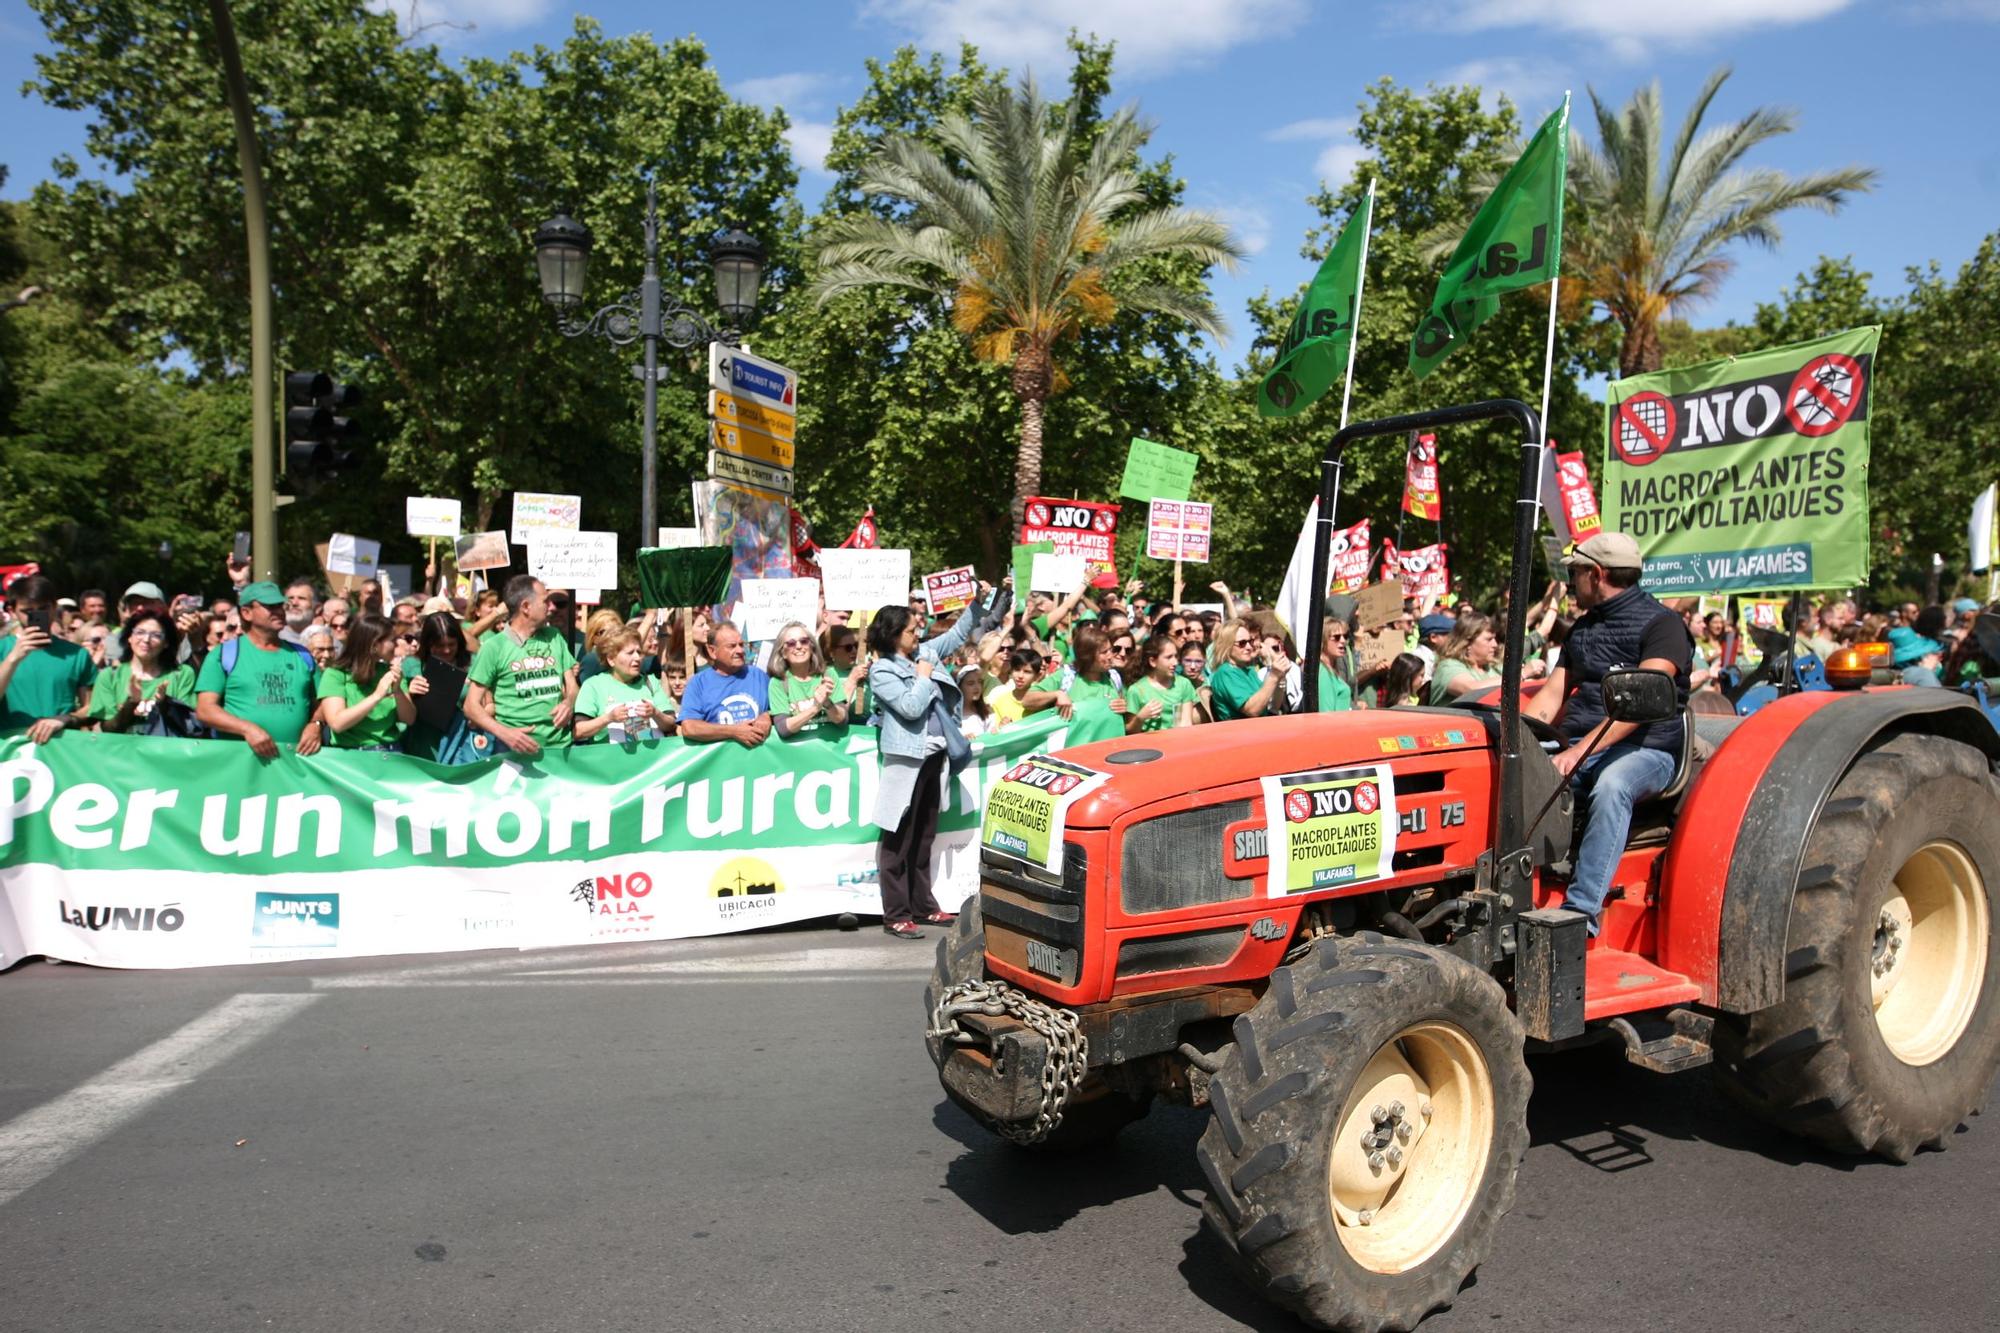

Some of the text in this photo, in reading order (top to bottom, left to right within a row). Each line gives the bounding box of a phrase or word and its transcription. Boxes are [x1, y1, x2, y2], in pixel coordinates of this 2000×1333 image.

[744, 371, 783, 393] TOURIST INFO
[1681, 384, 1782, 447] NO
[771, 445, 791, 460] REAL
[1620, 447, 1845, 507] MACROPLANTES
[1052, 506, 1091, 528] NO
[1619, 484, 1845, 537] FOTOVOLTAIQUES
[1027, 529, 1110, 549] MACROPLANTES
[1707, 547, 1807, 579] VILAFAMÉS
[940, 573, 959, 586] NO
[1664, 574, 1695, 585] nostra
[523, 657, 546, 669] NO
[515, 668, 559, 682] MAGDA
[1021, 767, 1058, 787] NO
[0, 745, 180, 851] Per
[200, 792, 343, 858] un
[372, 761, 612, 858] món
[641, 734, 882, 844] rural
[992, 788, 1051, 817] MACROPLANTES
[1313, 789, 1352, 815] NO
[988, 802, 1048, 832] FOTOVOLTAIQUES
[1440, 801, 1466, 827] 75
[1291, 822, 1378, 846] MACROPLANTES
[1291, 838, 1378, 861] FOTOVOLTAIQUES
[596, 872, 653, 900] NO
[59, 900, 185, 932] LaUNIÓ
[262, 901, 333, 915] JUNTS
[600, 901, 640, 915] A LA
[718, 897, 776, 912] UBICACIÓ
[1026, 940, 1062, 978] SAME
